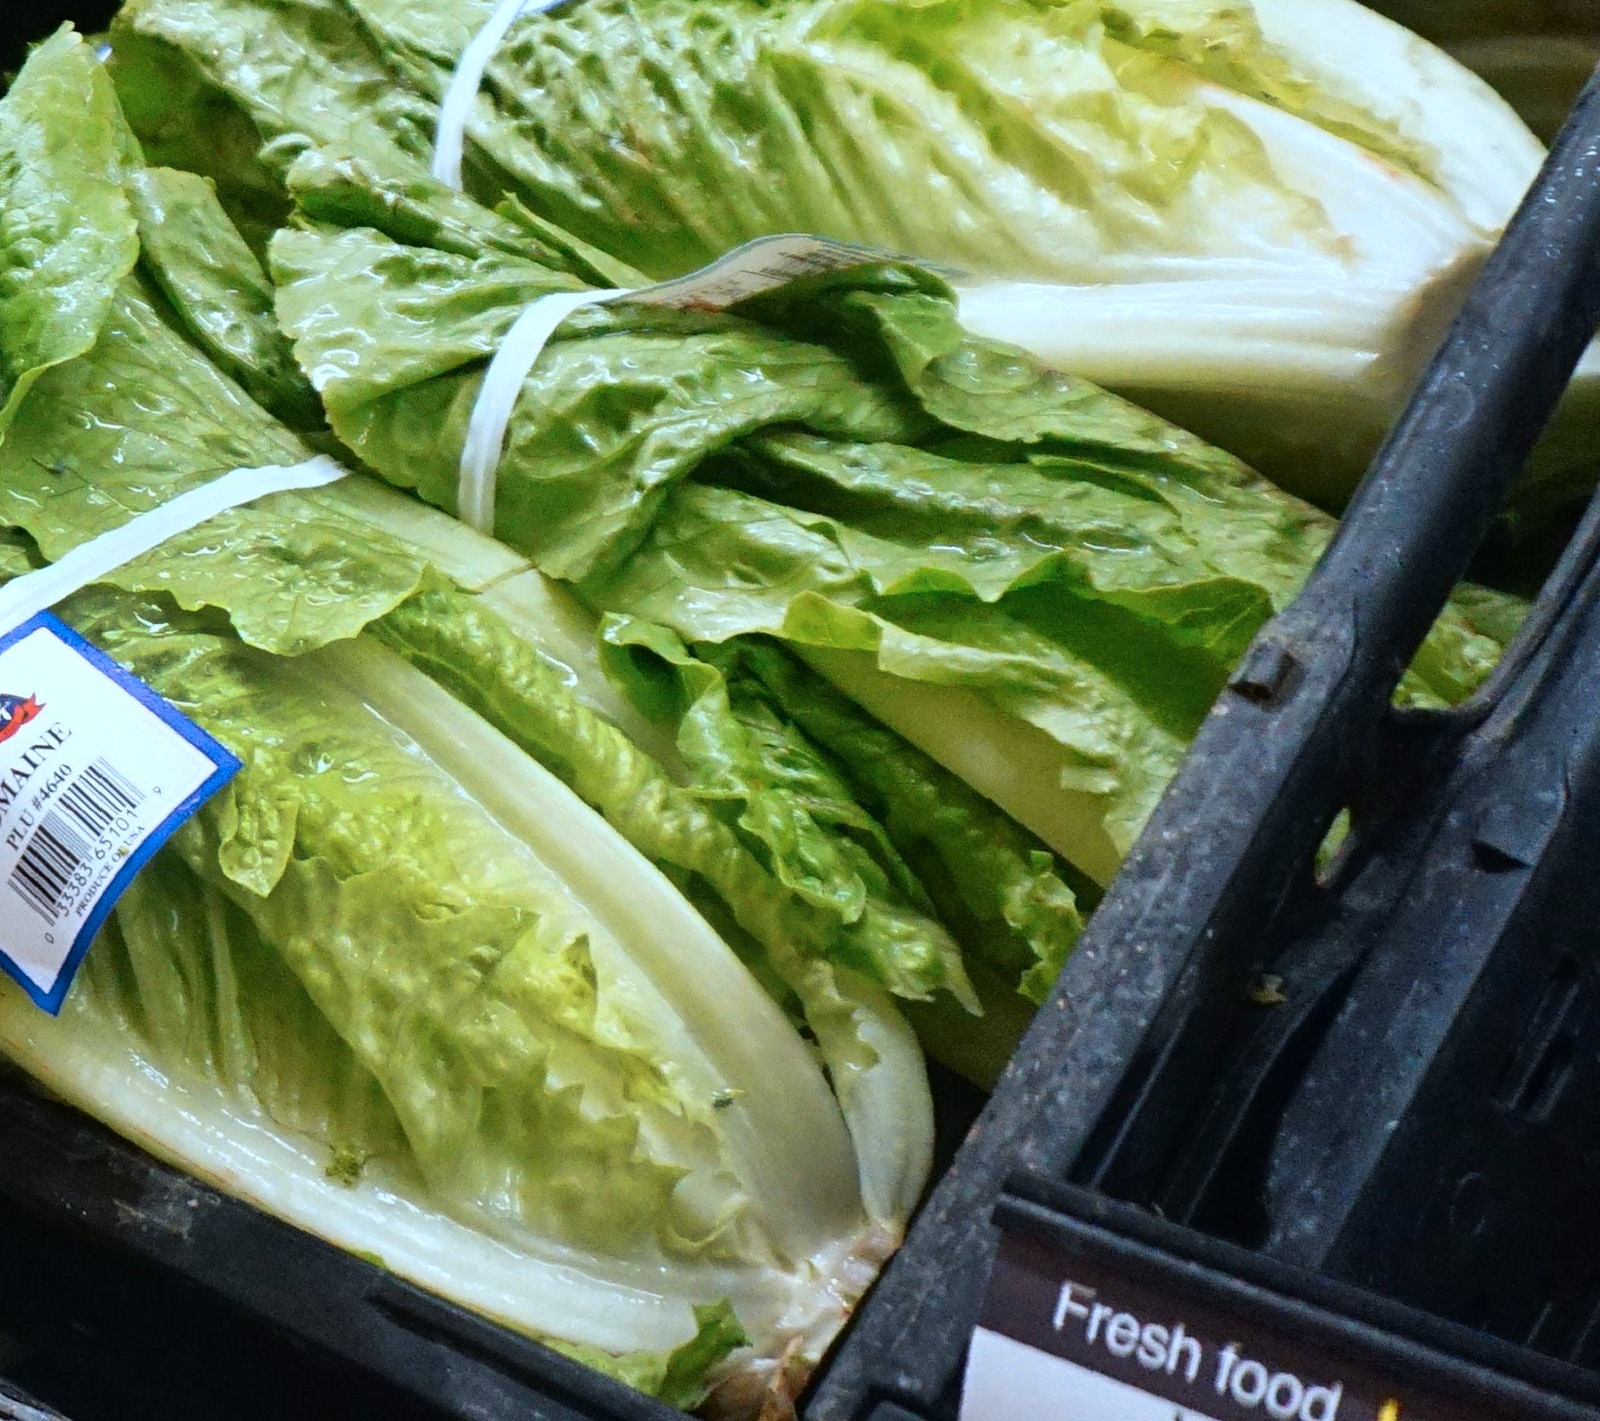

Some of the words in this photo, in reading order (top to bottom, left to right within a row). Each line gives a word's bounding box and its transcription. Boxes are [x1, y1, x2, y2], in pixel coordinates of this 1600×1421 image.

[5, 809, 36, 851] PLU
[31, 763, 73, 812] #4640
[56, 861, 94, 919] 33383
[94, 808, 139, 861] 65101
[75, 860, 114, 918] PRODUCE
[123, 825, 146, 847] USA
[1051, 1279, 1202, 1383] Fresh
